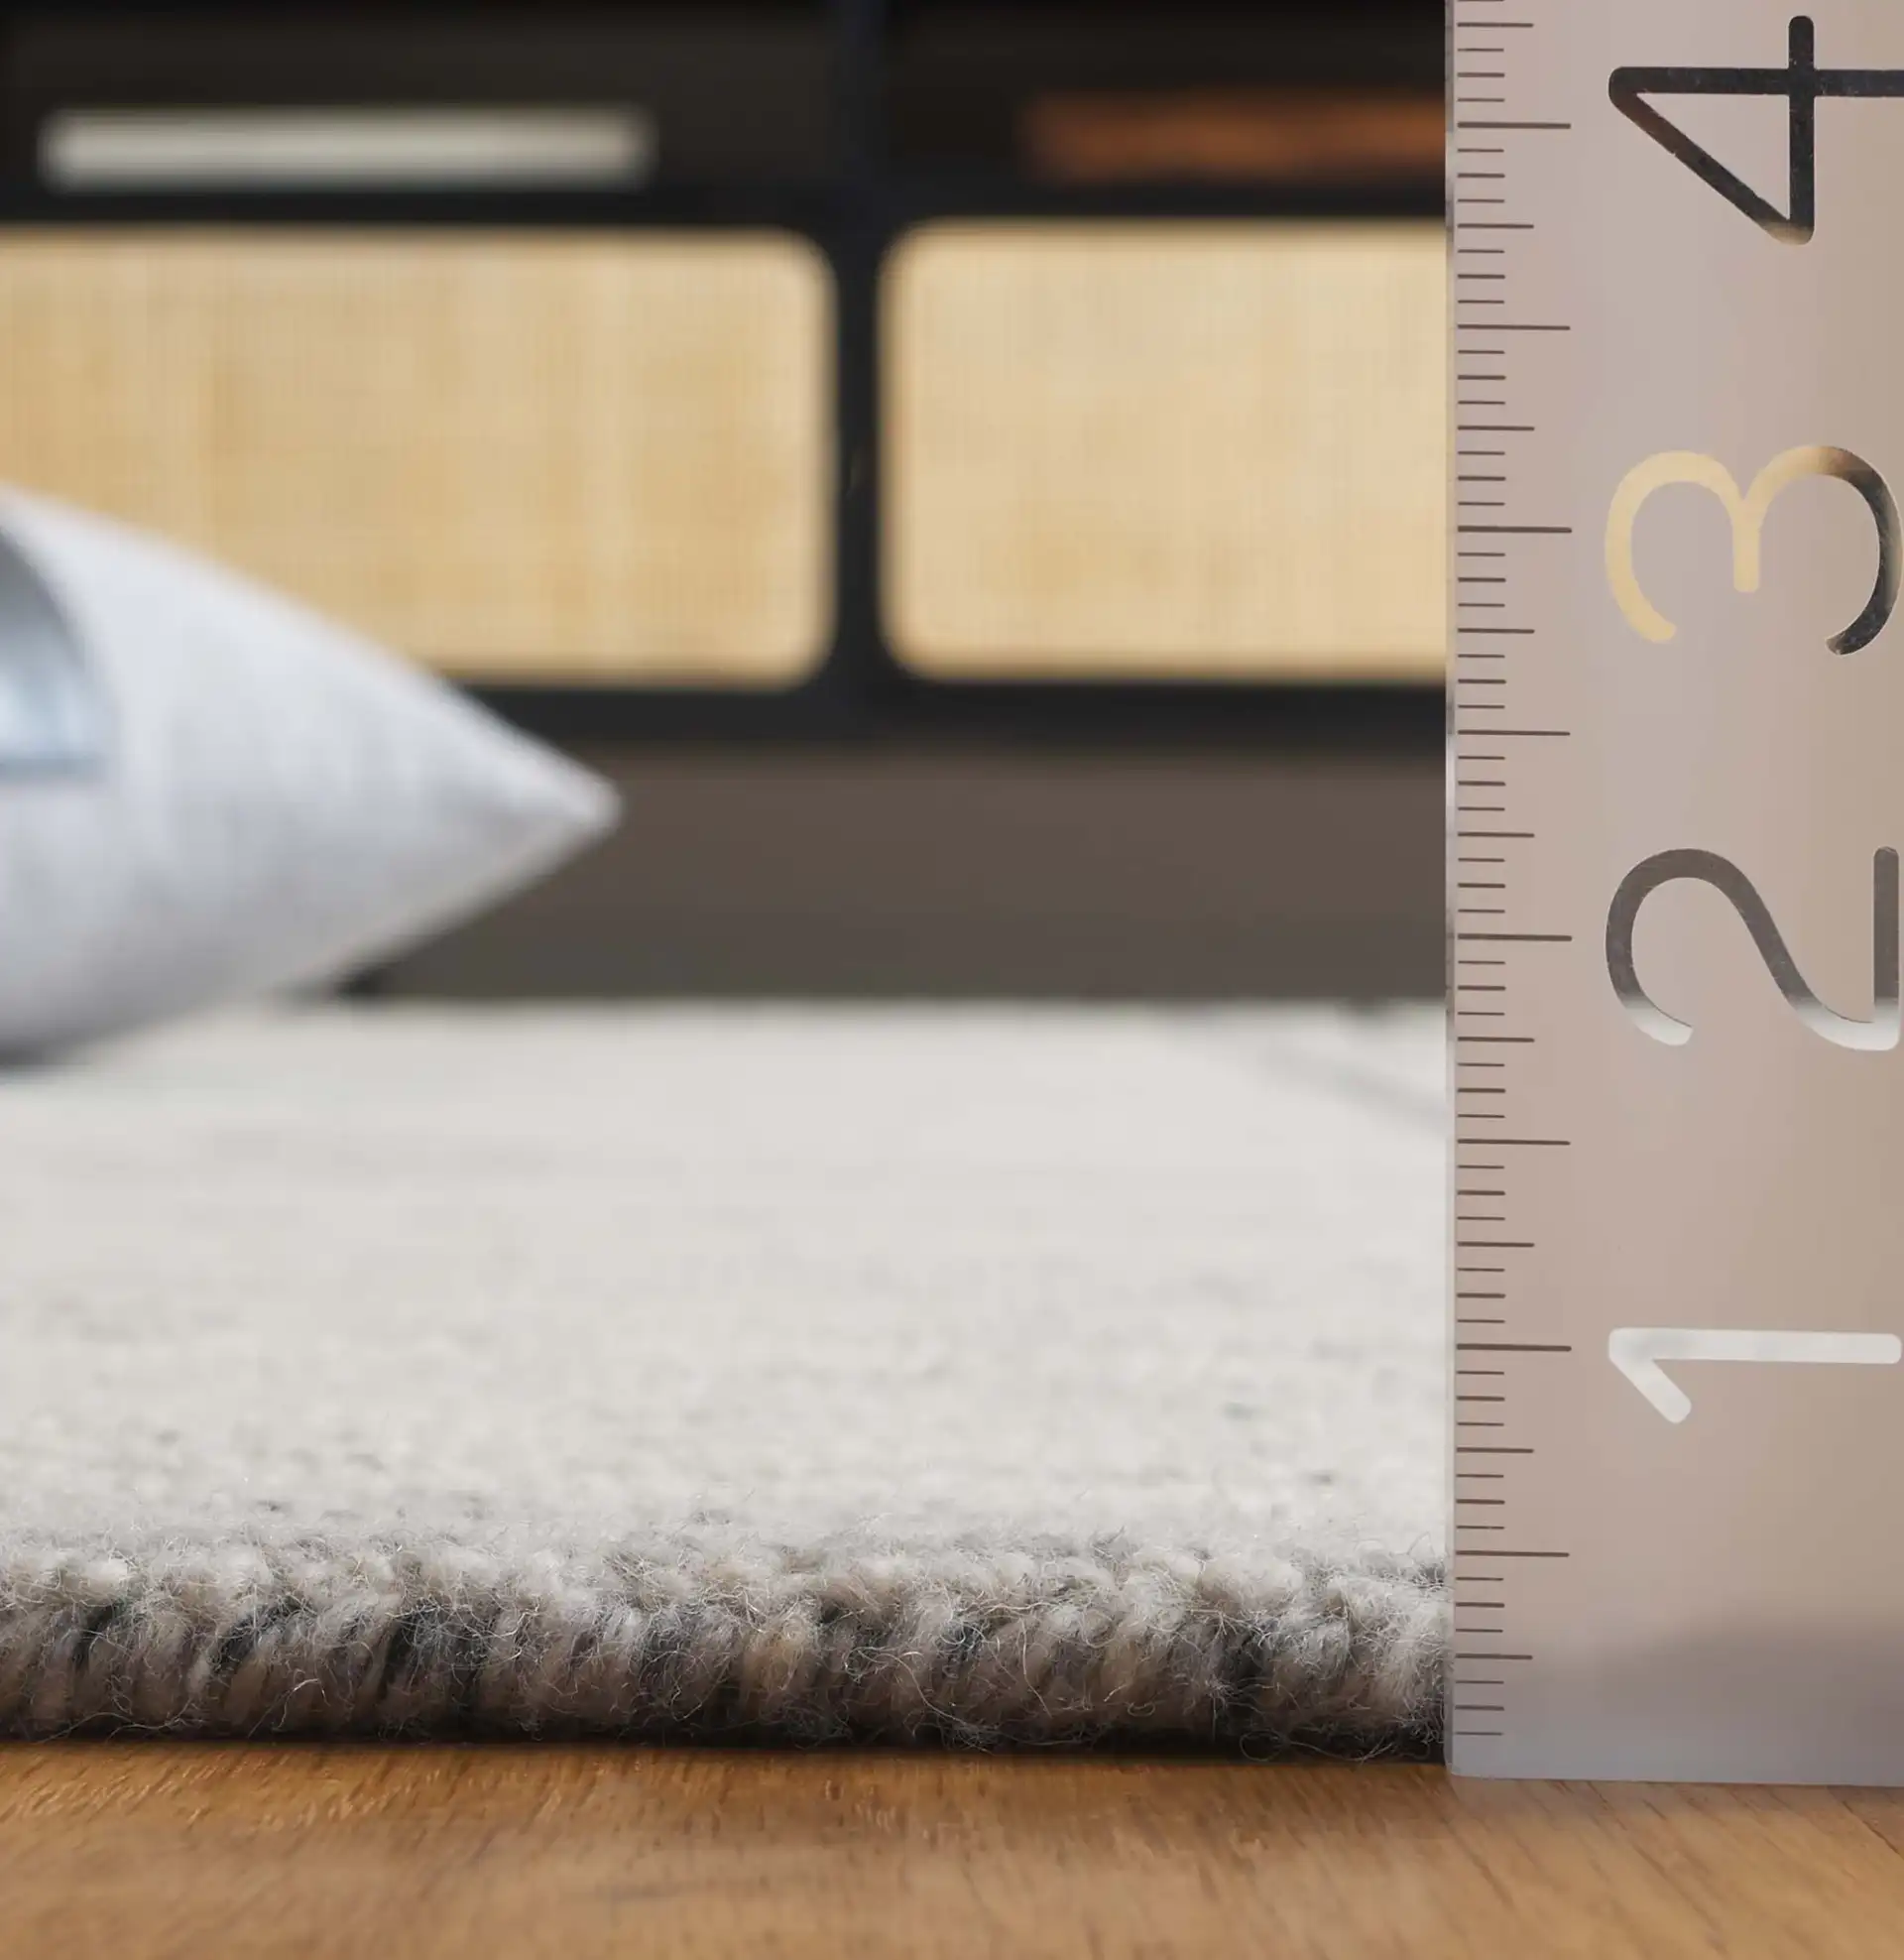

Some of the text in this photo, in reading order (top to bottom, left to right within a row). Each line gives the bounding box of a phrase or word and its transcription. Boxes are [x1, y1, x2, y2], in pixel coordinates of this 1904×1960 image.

[1608, 16, 1904, 245] 4
[1605, 445, 1903, 655] 3
[1605, 846, 1900, 1050] 2
[1608, 1327, 1902, 1423] 1
